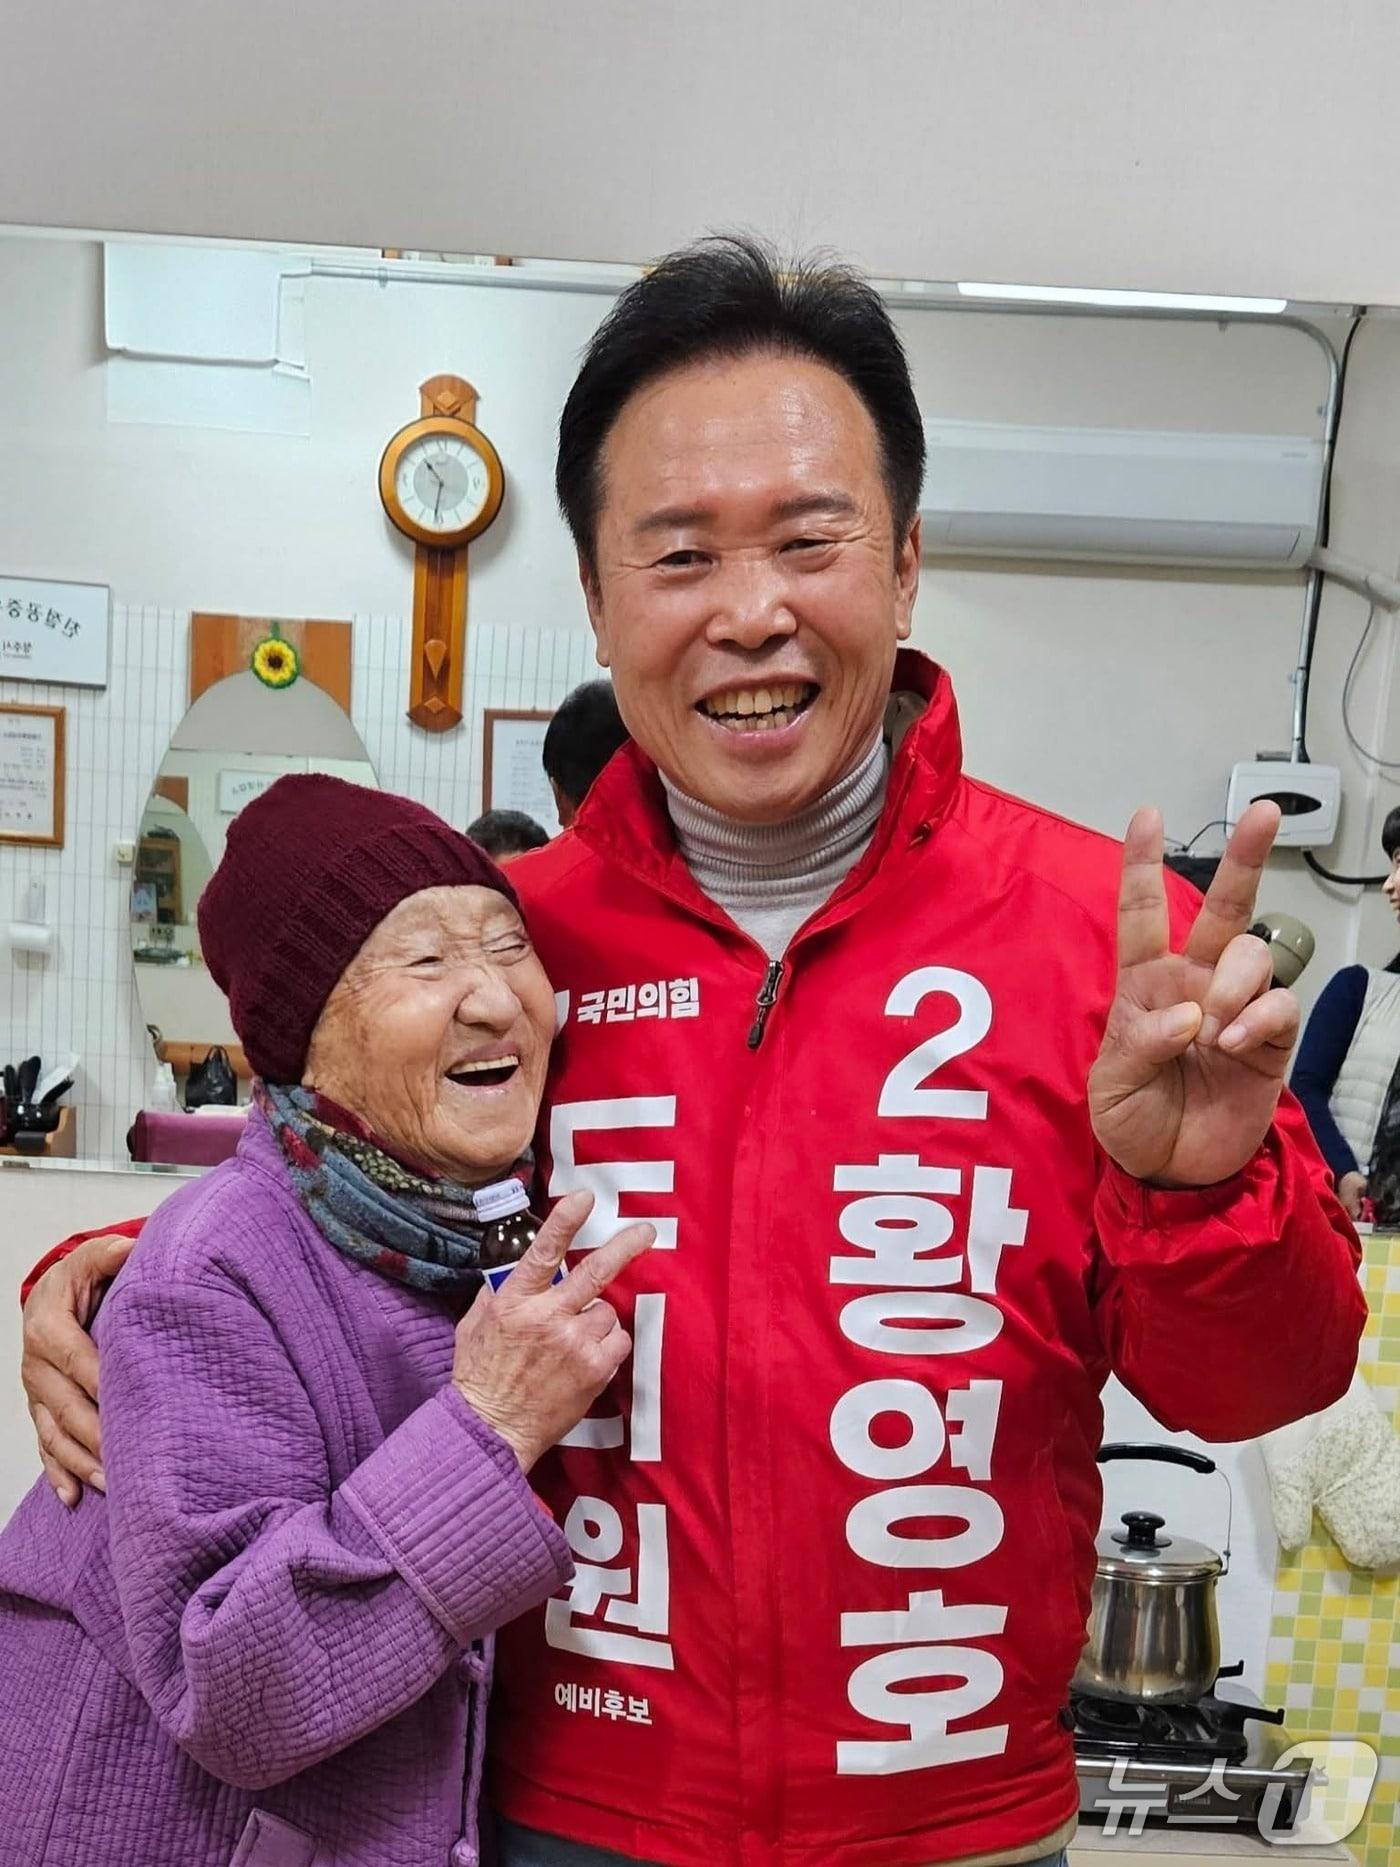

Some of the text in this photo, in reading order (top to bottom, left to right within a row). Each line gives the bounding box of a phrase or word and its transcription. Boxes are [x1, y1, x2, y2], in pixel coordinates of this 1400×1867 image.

[577, 977, 701, 1024] 국민의힘
[829, 965, 1030, 1776] 2 황영호
[554, 1683, 653, 1726] 예비후보
